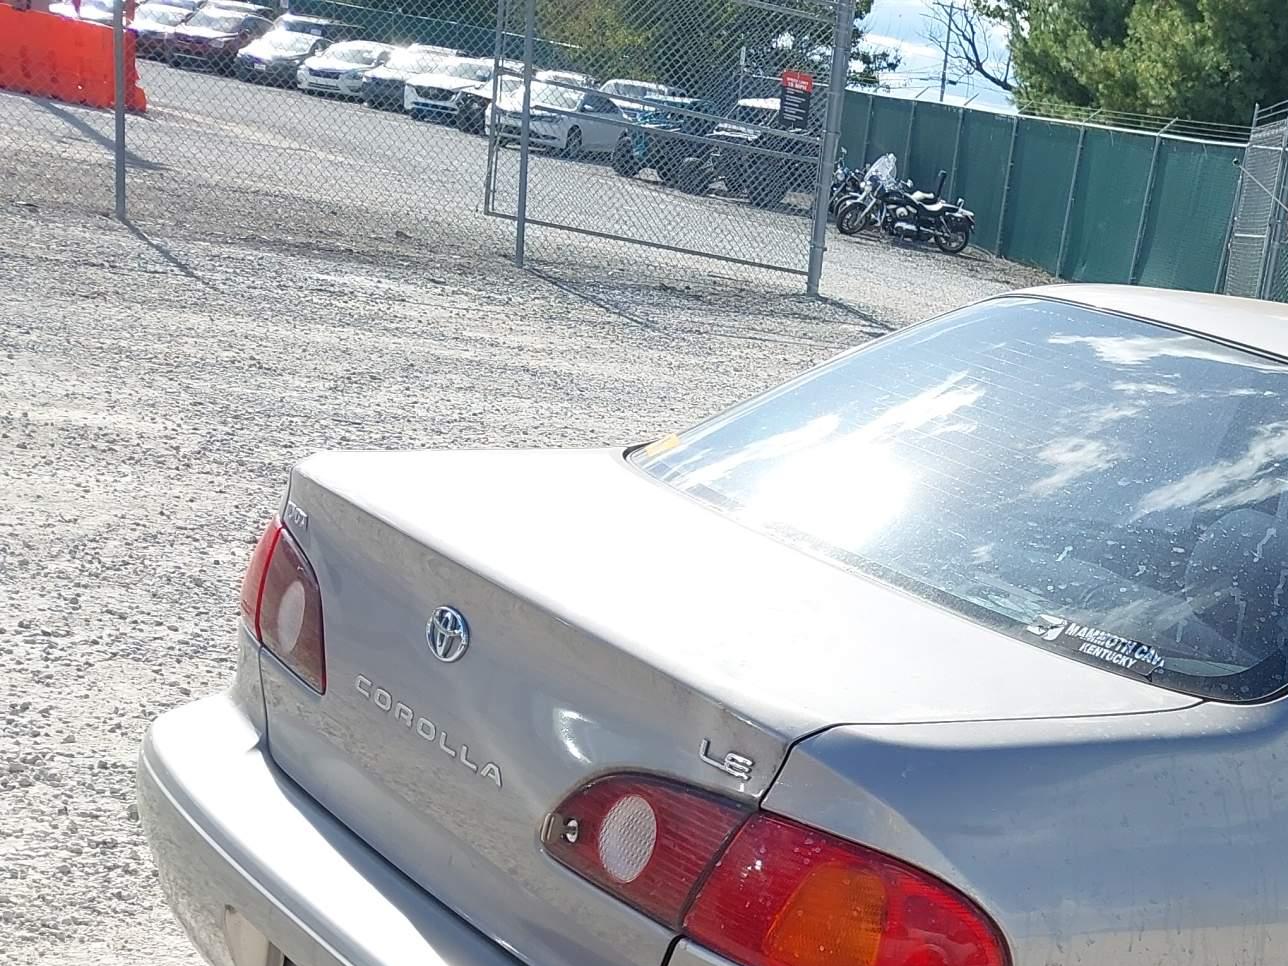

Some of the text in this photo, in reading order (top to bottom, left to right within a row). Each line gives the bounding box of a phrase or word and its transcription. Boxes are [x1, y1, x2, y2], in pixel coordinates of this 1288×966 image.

[1078, 641, 1137, 669] KENTUCKY
[354, 673, 503, 789] COROLLA
[699, 738, 755, 780] LE
